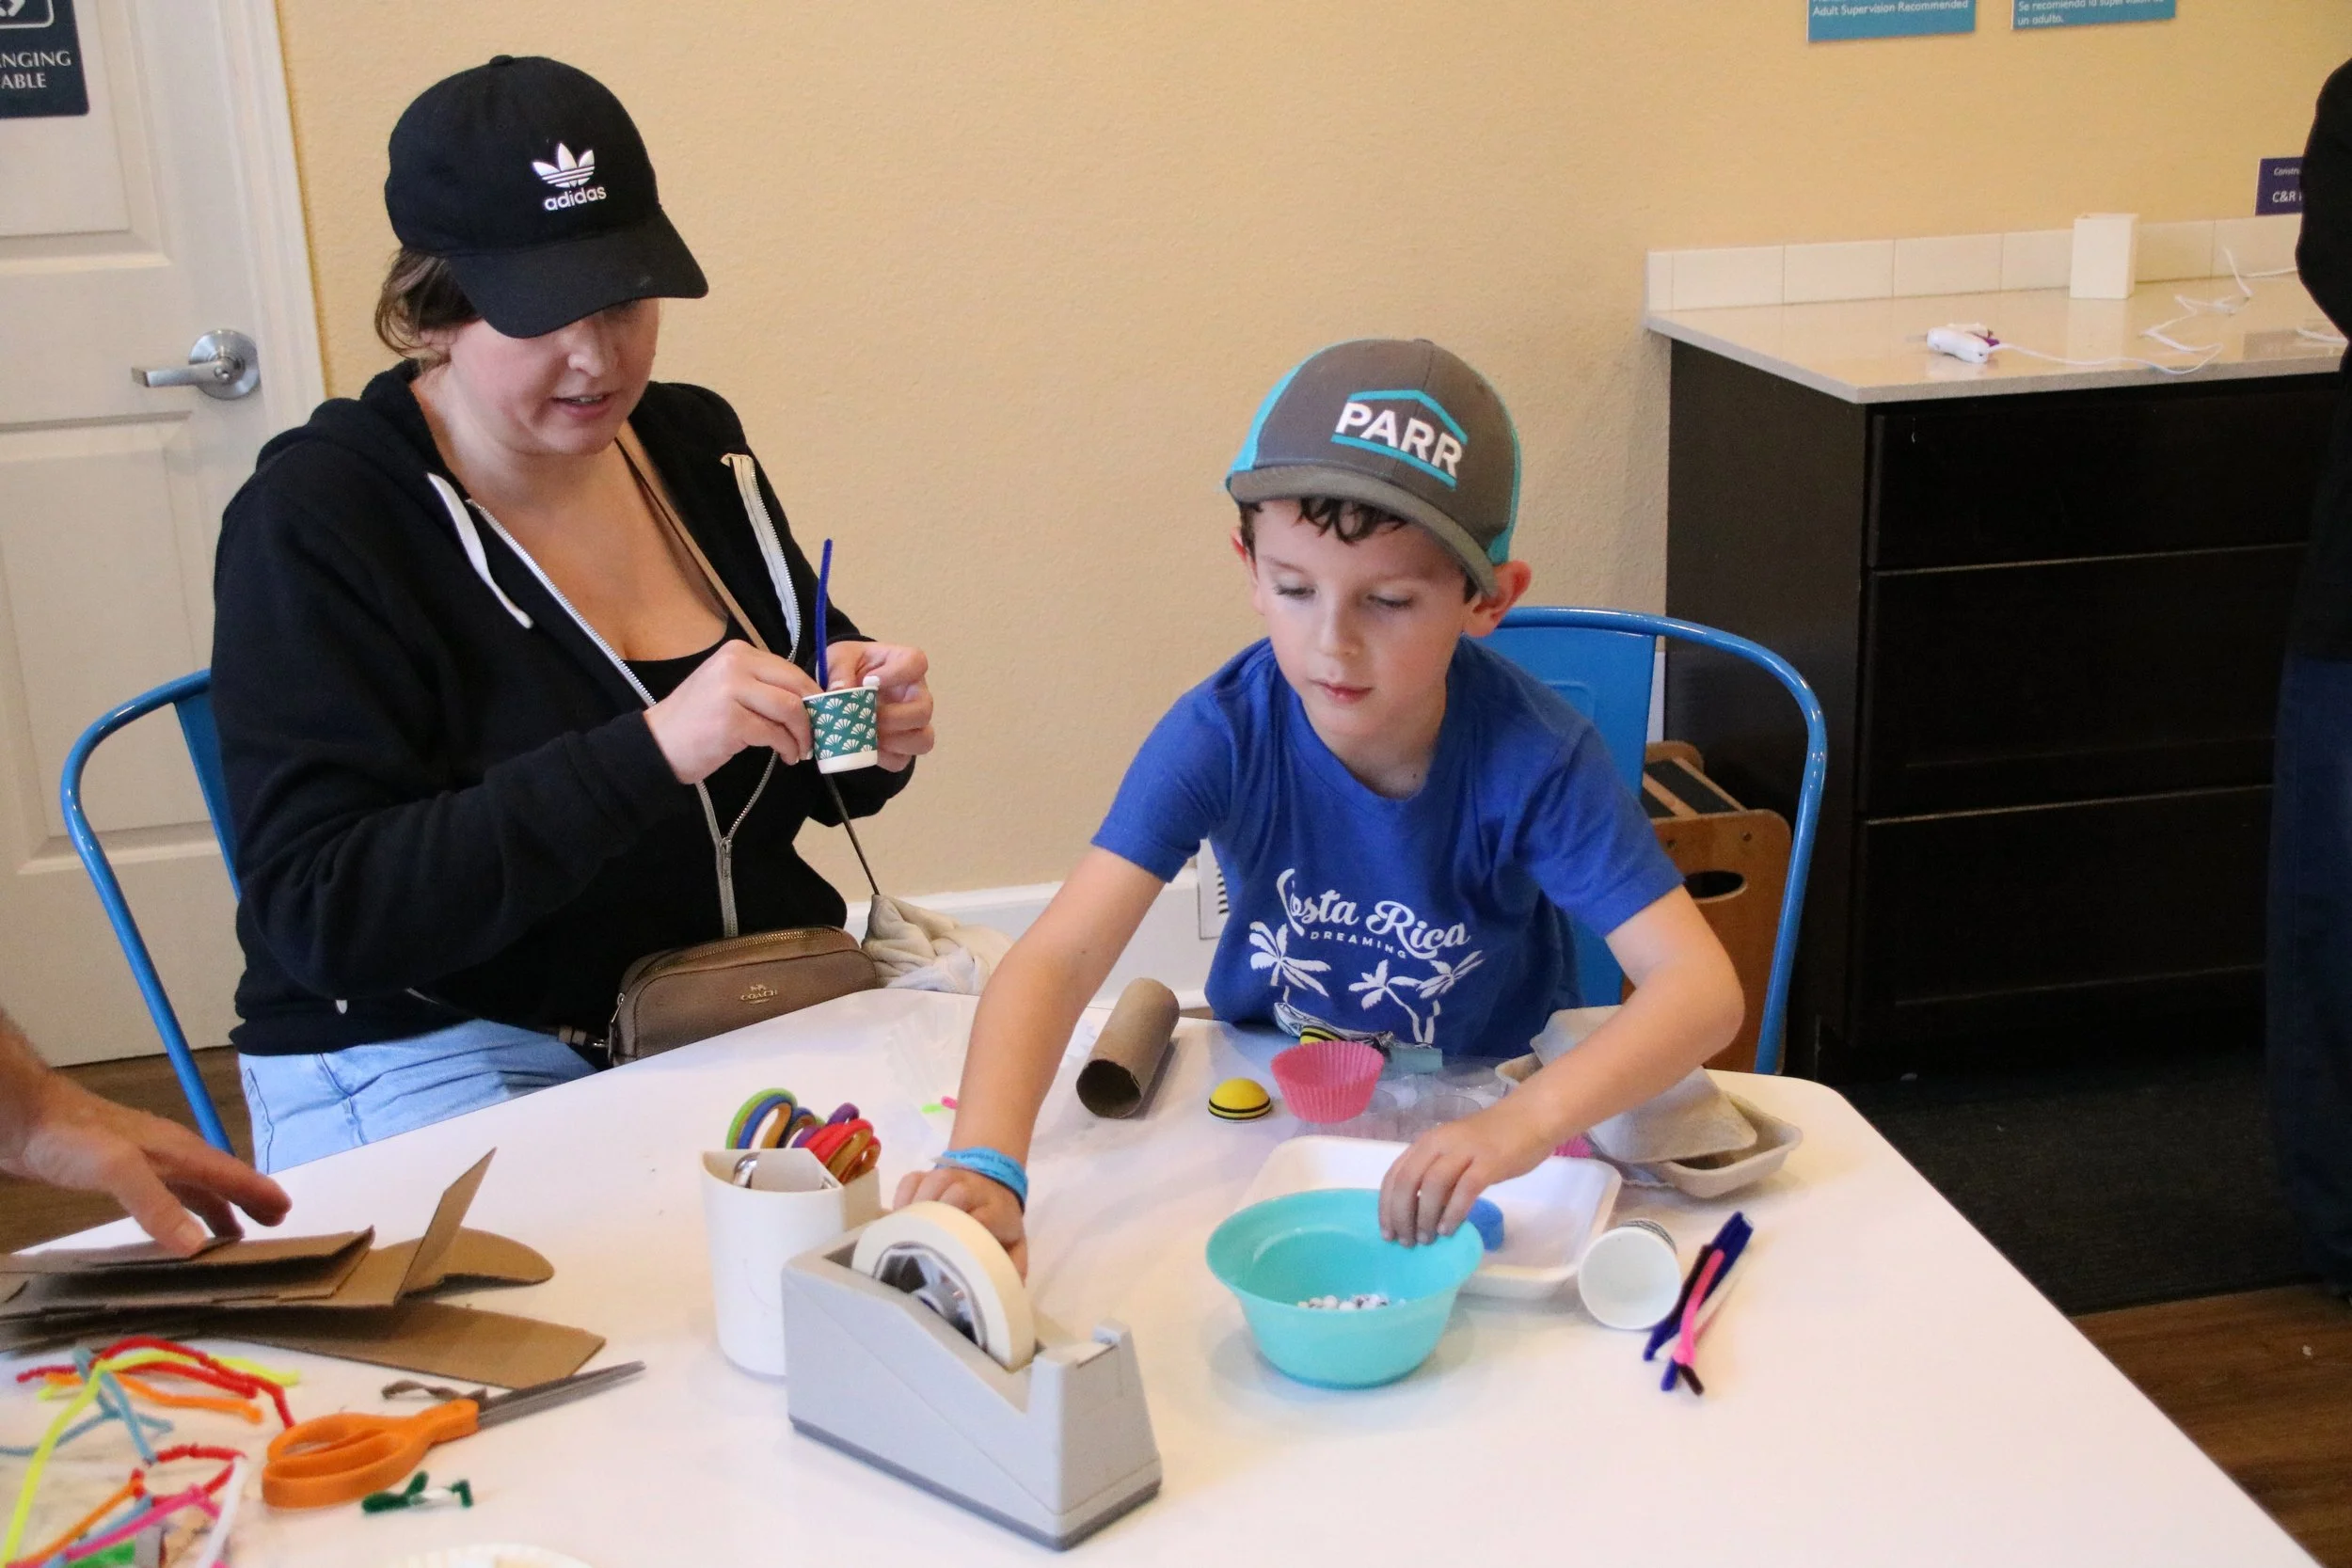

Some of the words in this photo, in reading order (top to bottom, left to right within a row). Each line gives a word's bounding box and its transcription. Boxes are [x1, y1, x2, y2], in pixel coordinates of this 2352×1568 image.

[1812, 6, 1839, 16] Adult
[1841, 4, 1895, 18] Supervision
[1899, 0, 1968, 12] Recommended
[2018, 17, 2029, 25] un
[2032, 13, 2064, 24] adulto.
[0, 50, 72, 69] NGING
[545, 186, 608, 211] adidas
[2272, 190, 2296, 202] C&R
[1335, 402, 1463, 478] PARR
[1365, 900, 1470, 959] Rica
[1310, 929, 1406, 959] DREAMING
[739, 989, 778, 1001] COACH
